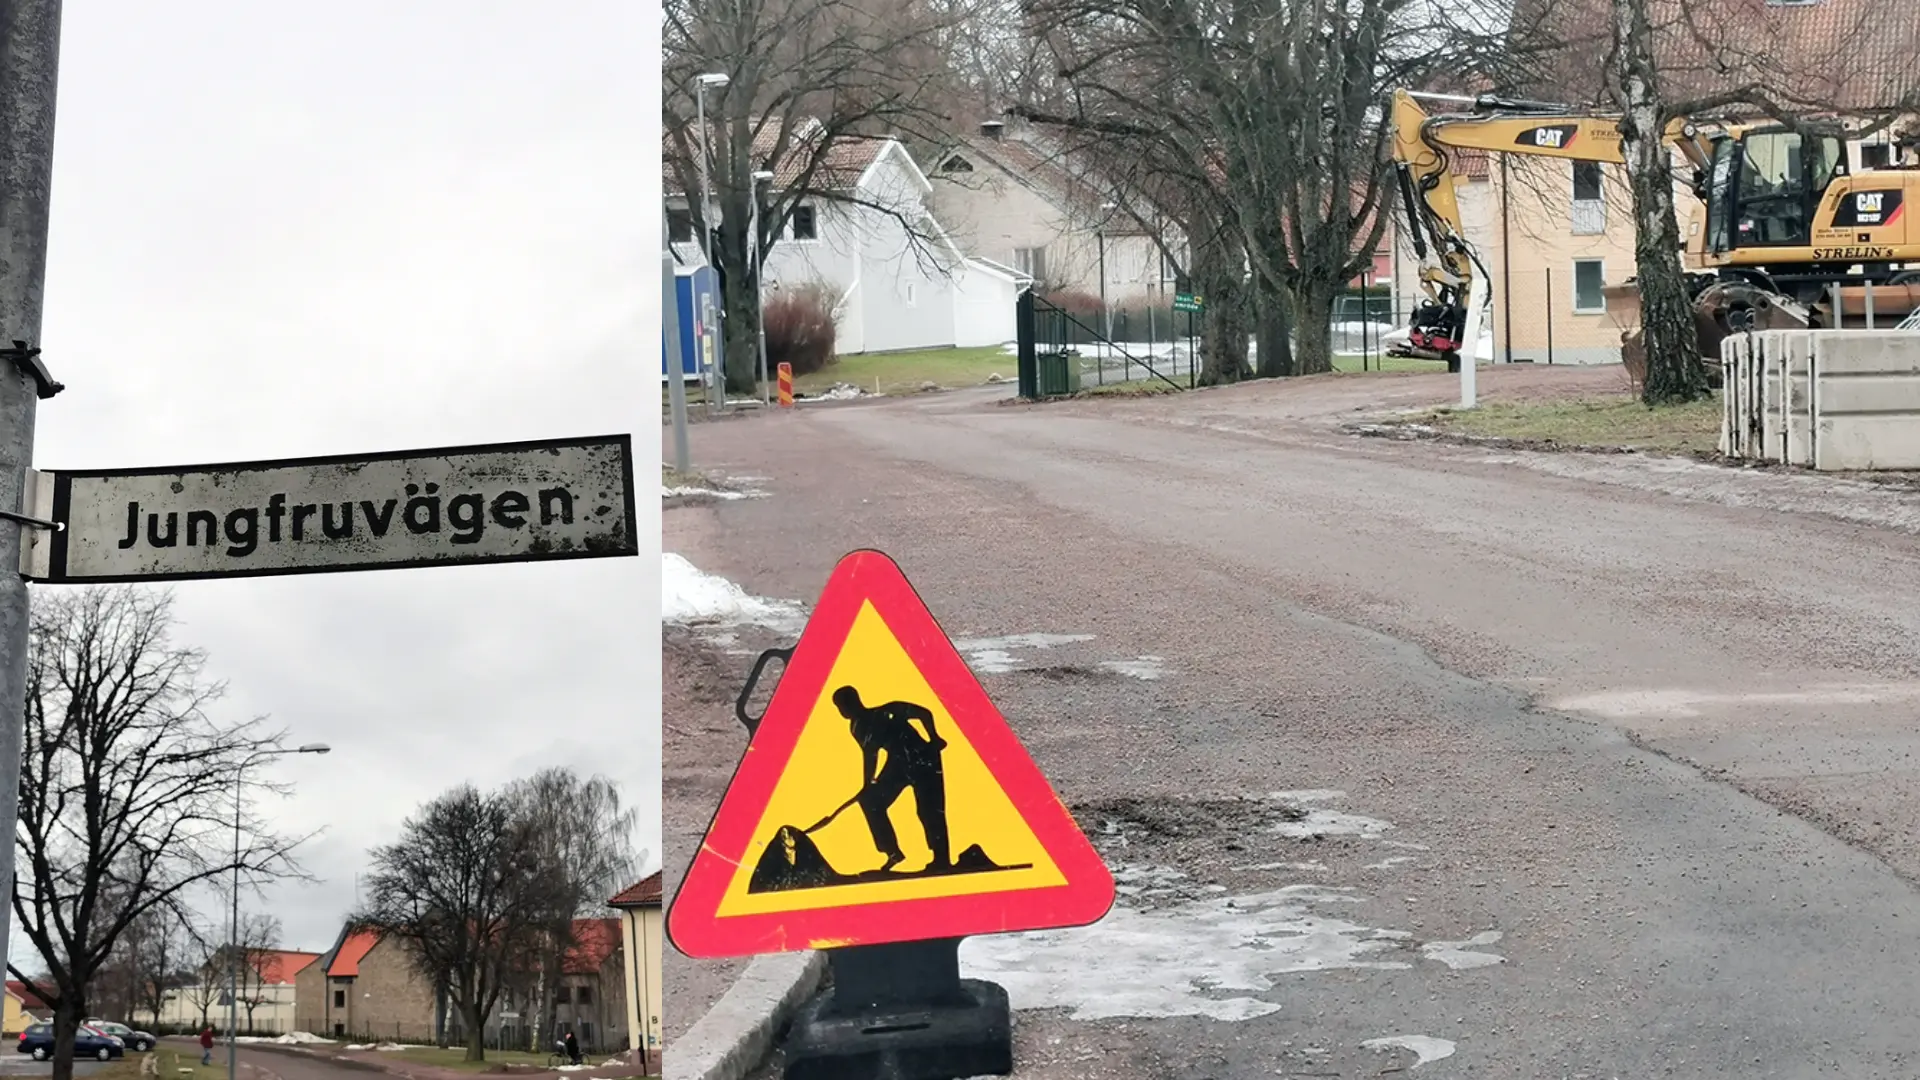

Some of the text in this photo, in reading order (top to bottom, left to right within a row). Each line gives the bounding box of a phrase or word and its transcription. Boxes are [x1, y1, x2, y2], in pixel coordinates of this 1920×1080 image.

[1535, 128, 1563, 147] CAT
[1856, 193, 1884, 212] CAT
[117, 483, 575, 557] Jungfruvägen
